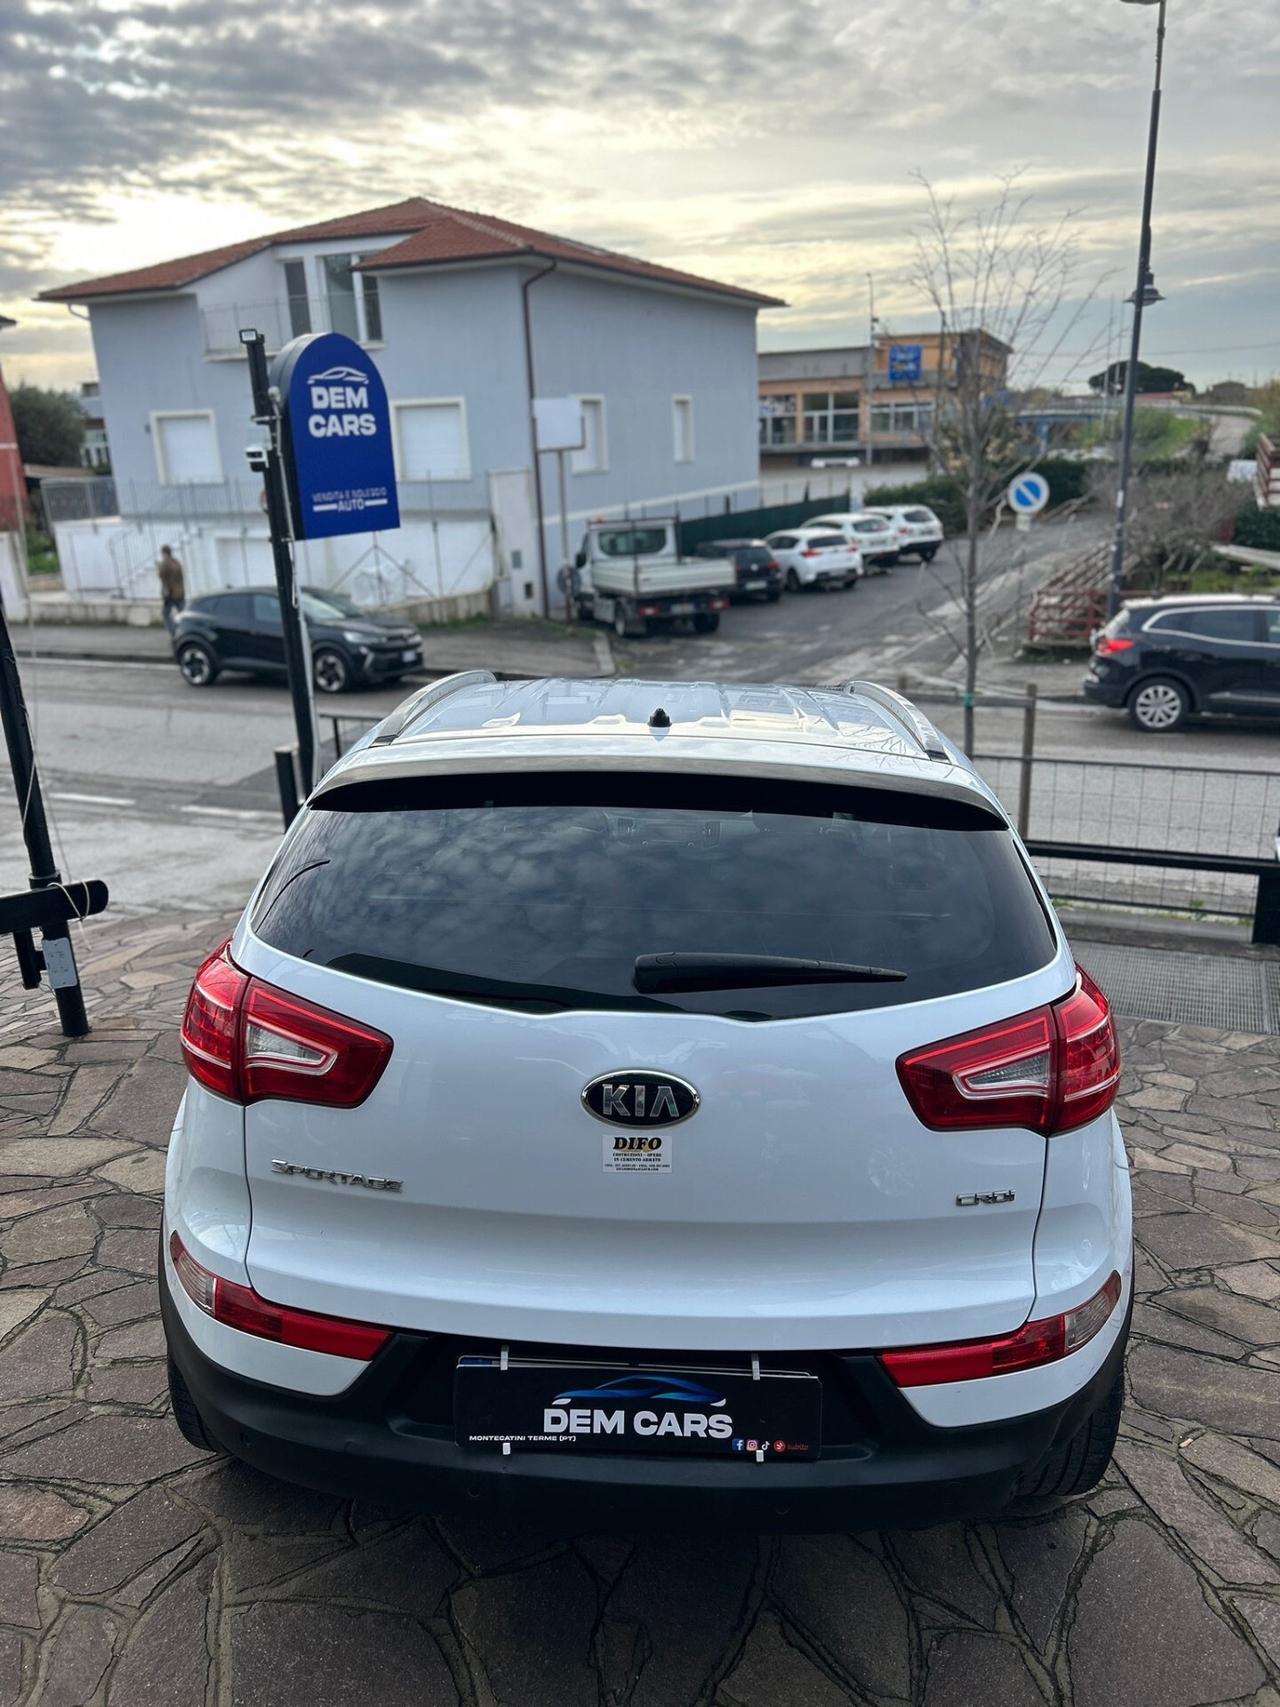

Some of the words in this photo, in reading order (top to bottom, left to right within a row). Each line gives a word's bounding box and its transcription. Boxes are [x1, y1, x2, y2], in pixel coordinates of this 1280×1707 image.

[310, 386, 369, 409] DEM
[308, 413, 377, 438] CARS
[338, 498, 364, 512] AUTO
[602, 1083, 680, 1117] KIA
[613, 1137, 662, 1150] DIFO
[271, 1158, 403, 1193] SPORTAGE
[543, 1408, 625, 1435] DEM
[633, 1410, 733, 1439] CARS
